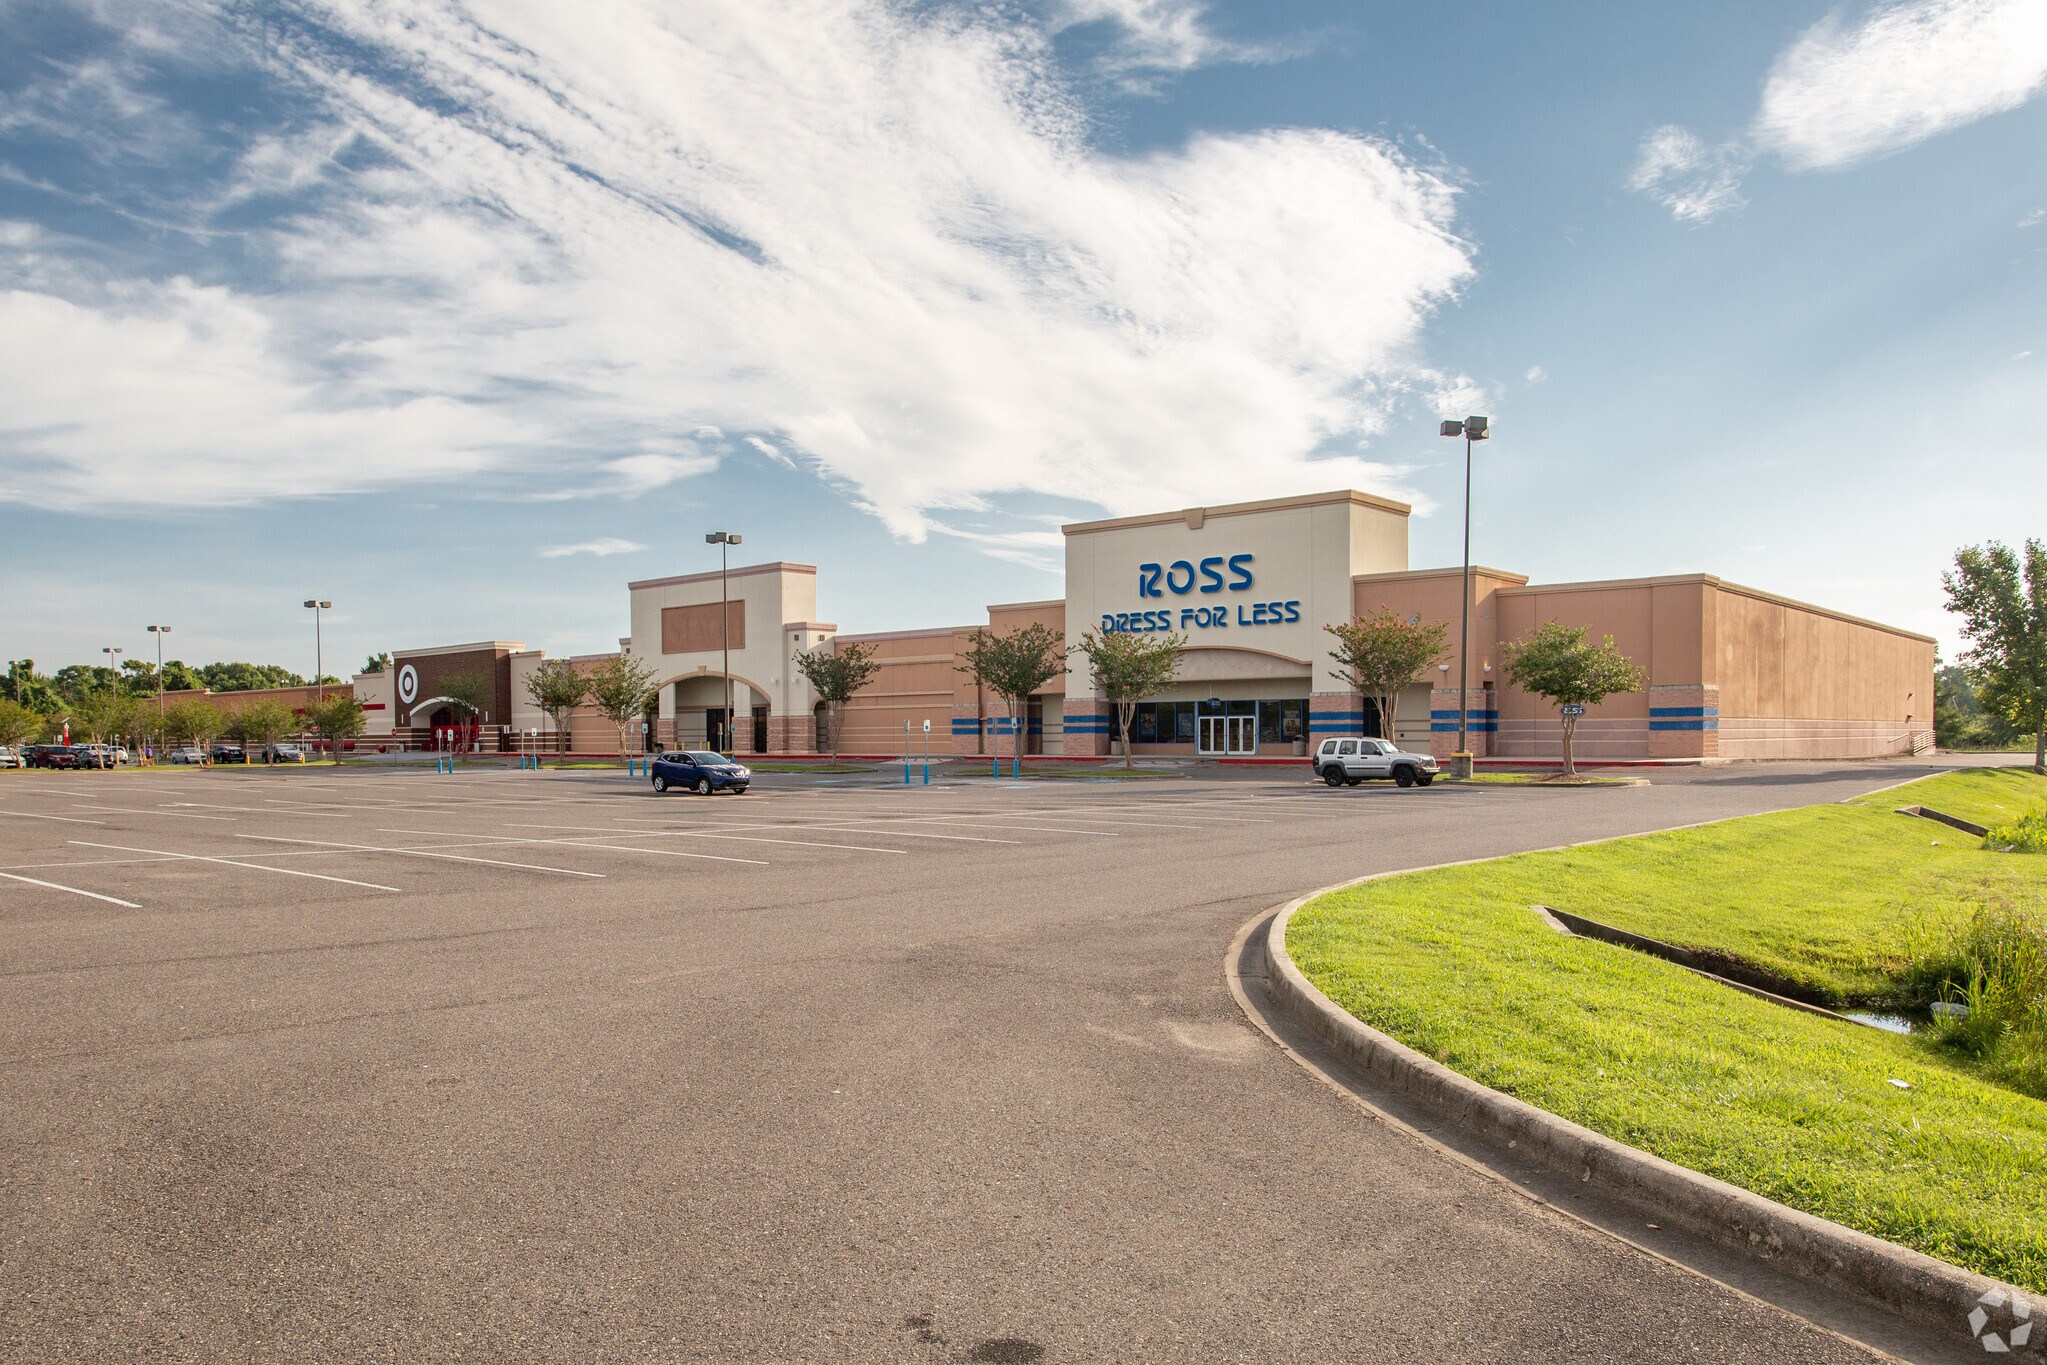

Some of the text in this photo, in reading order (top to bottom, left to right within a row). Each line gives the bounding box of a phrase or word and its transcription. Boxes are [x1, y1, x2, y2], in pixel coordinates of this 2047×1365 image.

[1139, 553, 1254, 598] ROSS
[1102, 600, 1301, 634] DRESS FOR LESS
